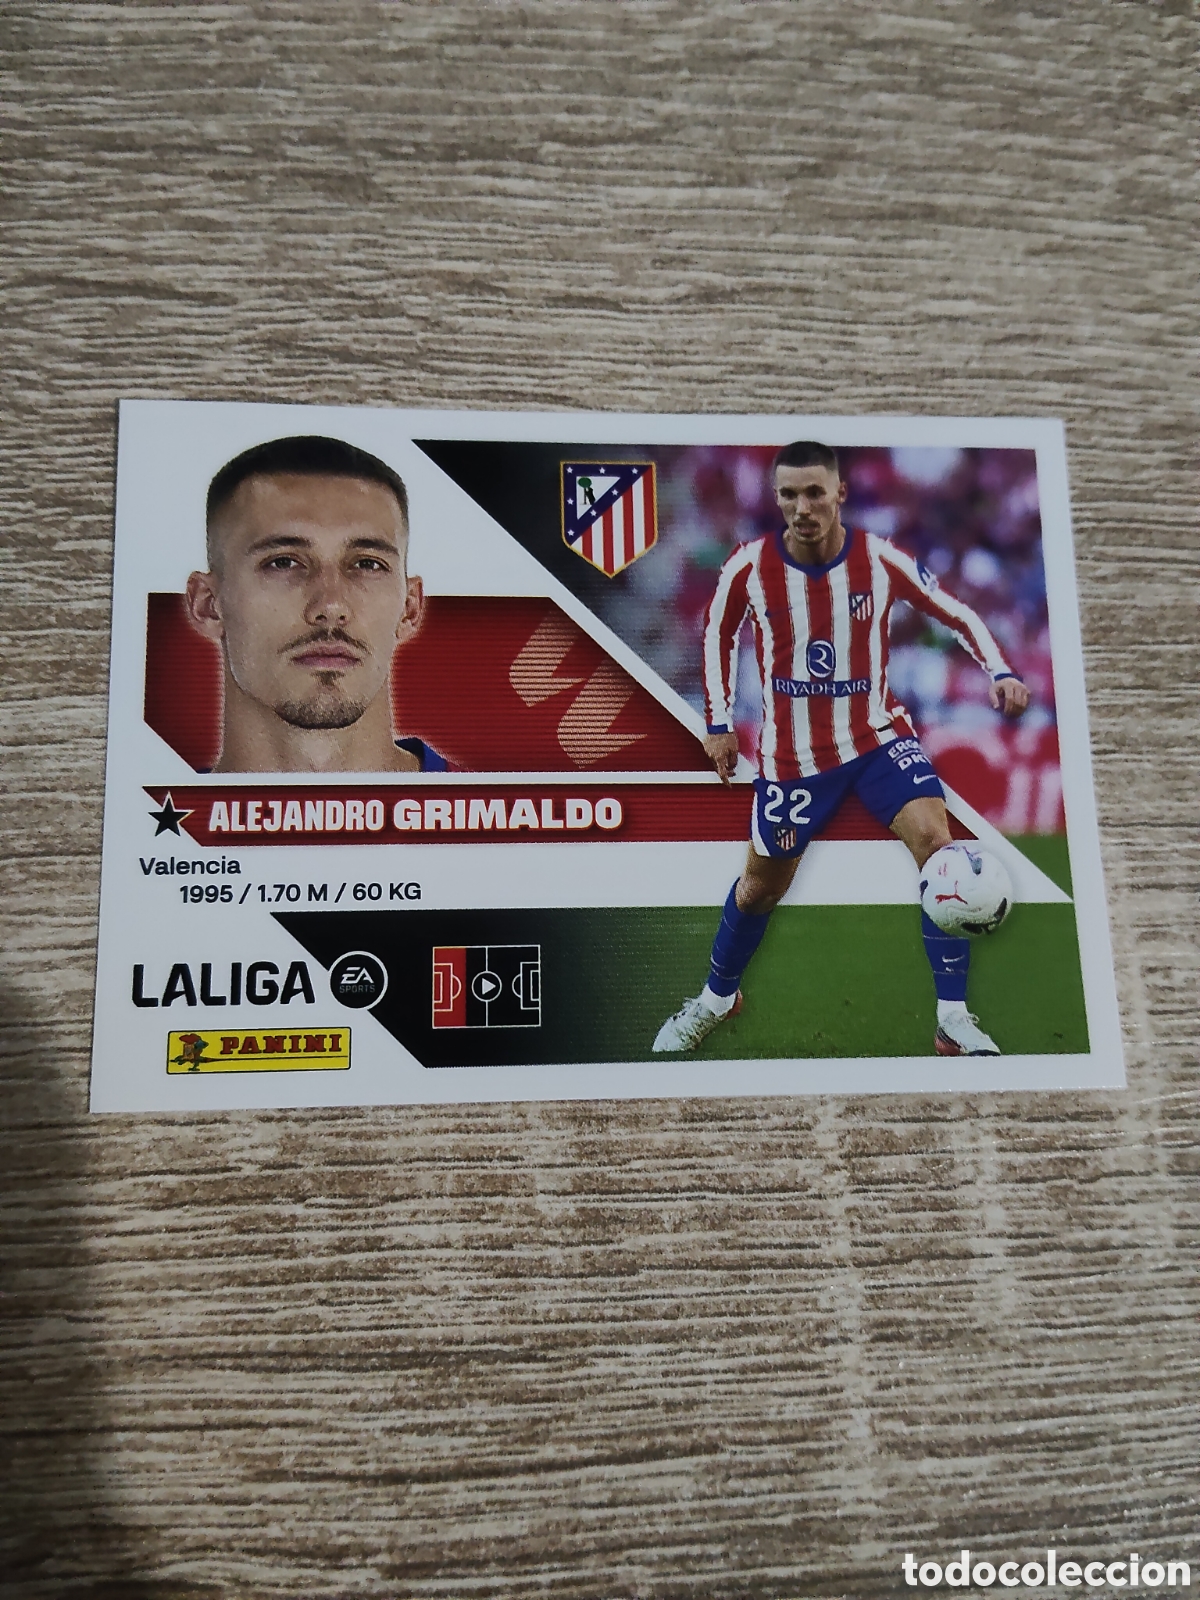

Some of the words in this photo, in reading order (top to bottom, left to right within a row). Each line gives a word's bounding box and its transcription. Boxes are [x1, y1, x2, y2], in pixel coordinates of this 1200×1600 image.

[775, 678, 836, 696] RIYADH
[841, 679, 868, 694] AIR
[208, 800, 385, 832] ALEJANDRO
[393, 797, 623, 830] GRIMALDO
[764, 783, 812, 825] 22
[139, 856, 242, 875] Valencia
[179, 885, 234, 904] 1995
[238, 883, 252, 904] /
[258, 884, 301, 902] 1.70
[307, 883, 328, 902] M
[334, 882, 347, 903] /
[352, 882, 383, 901] 60
[389, 882, 422, 901] KG
[132, 961, 315, 1007] LALIGA
[340, 966, 375, 984] EA
[339, 984, 376, 994] SPORTS
[220, 1034, 342, 1055] PANINI
